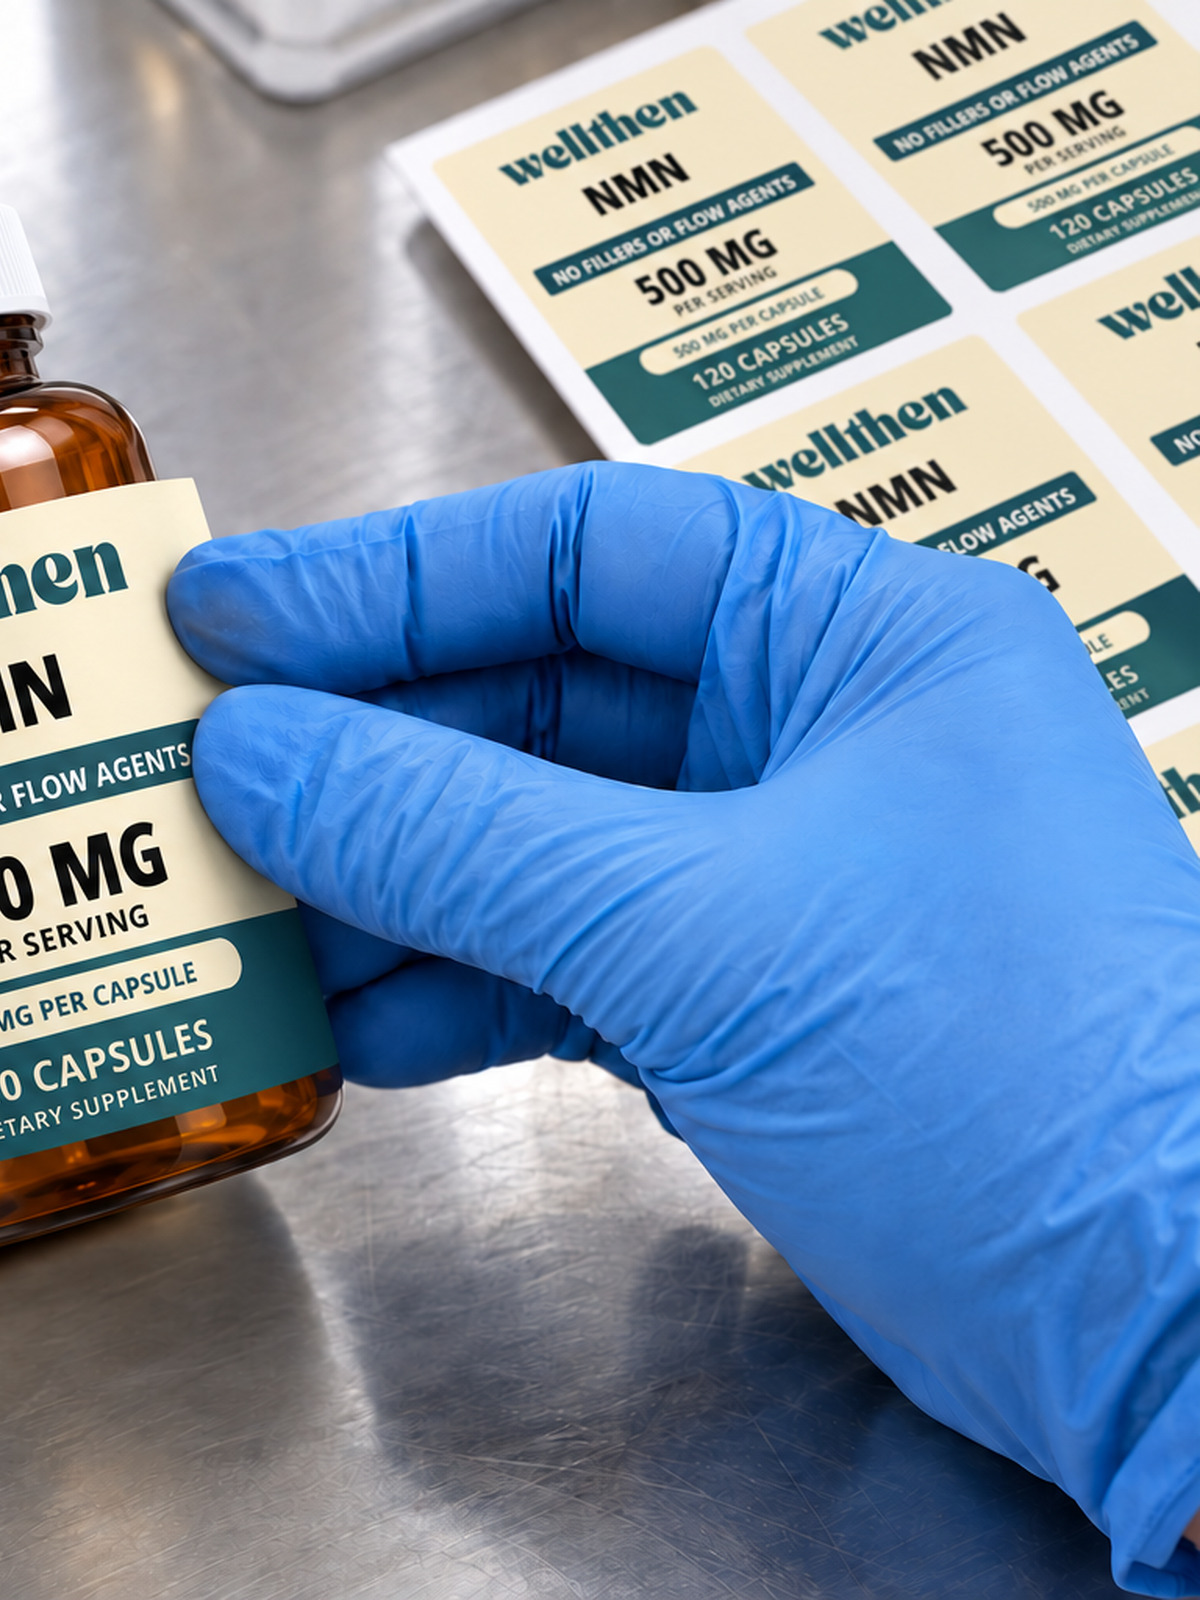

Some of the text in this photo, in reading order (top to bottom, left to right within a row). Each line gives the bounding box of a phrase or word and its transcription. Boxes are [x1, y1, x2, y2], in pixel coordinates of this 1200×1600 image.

[911, 12, 1028, 81] NMN
[893, 33, 1140, 154] NO FILLERS OR FLOW AGENTS
[981, 90, 1125, 167] 500 MG
[498, 91, 698, 186] wellthen
[1024, 125, 1127, 175] PER SERVING
[581, 153, 690, 216] NMN
[1027, 144, 1174, 214] 500 MG PER CAPSULE
[1050, 167, 1199, 240] 120 CAPSULES
[552, 174, 797, 287] NO FILLERS OR FLOW AGENTS
[1066, 225, 1123, 255] DIETARY
[634, 228, 778, 305] 500 MG
[673, 266, 778, 318] PER SERVING
[673, 286, 825, 359] 500 MG PER CAPSULE
[692, 313, 849, 391] 120 CAPSULES
[709, 335, 859, 408] DIETARY SUPPLEMENT
[741, 387, 968, 491] wellthen
[834, 459, 957, 527] NMN
[998, 487, 1077, 535] AGENTS
[11, 767, 87, 808] FLOW
[97, 743, 191, 788] AGENTS
[49, 822, 168, 906] MG
[25, 904, 150, 957] SERVING
[40, 991, 88, 1023] PER
[94, 961, 198, 1010] CAPSULE
[32, 1019, 214, 1092] CAPSULES
[71, 1065, 219, 1120] SUPPLEMENT
